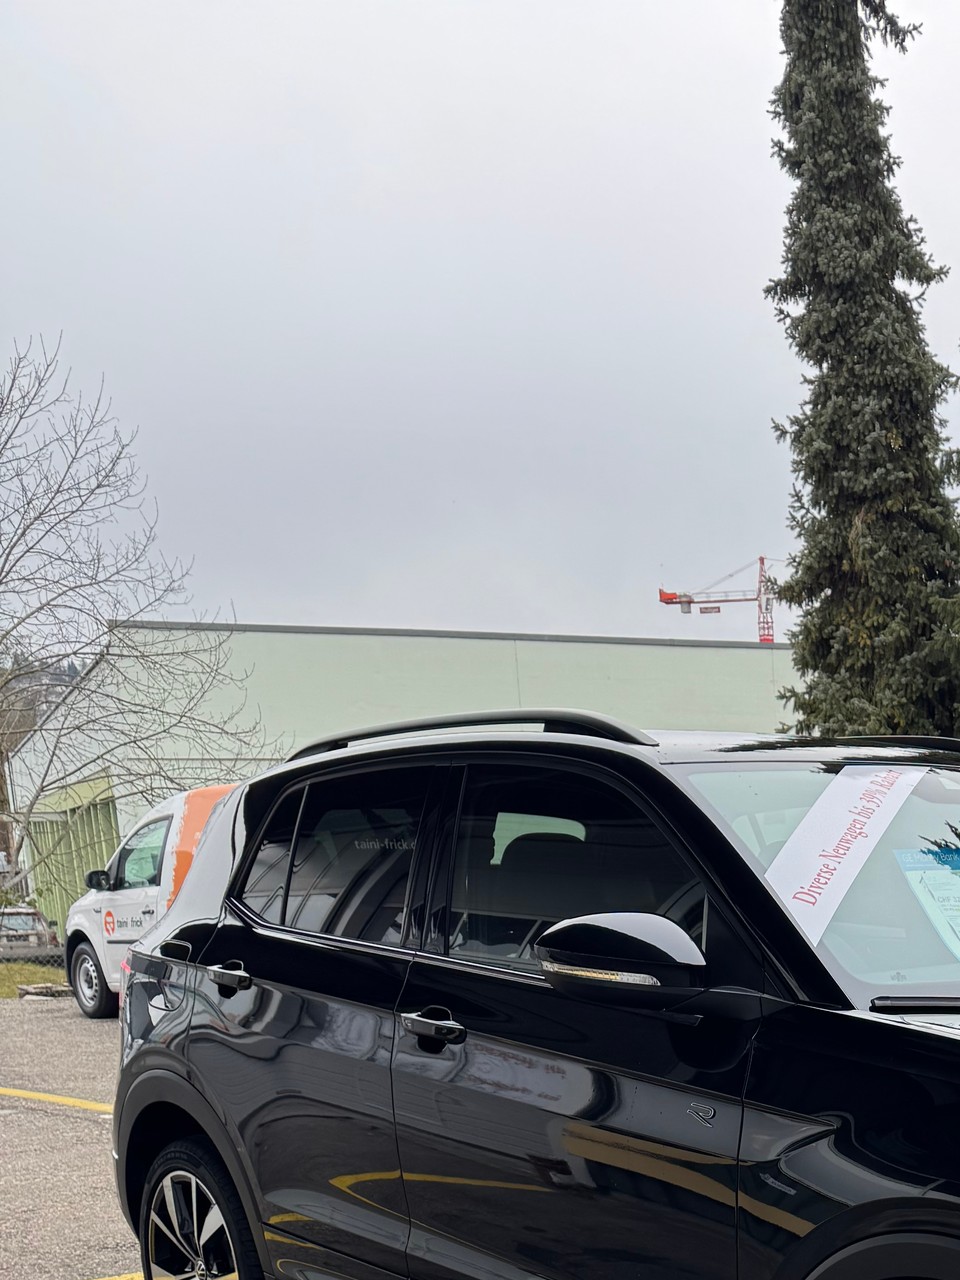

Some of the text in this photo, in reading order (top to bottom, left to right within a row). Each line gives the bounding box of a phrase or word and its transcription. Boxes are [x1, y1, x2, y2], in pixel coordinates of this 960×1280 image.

[792, 769, 903, 906] Diverse Neuwagen bis 39% Rabatt
[940, 852, 960, 861] Bank
